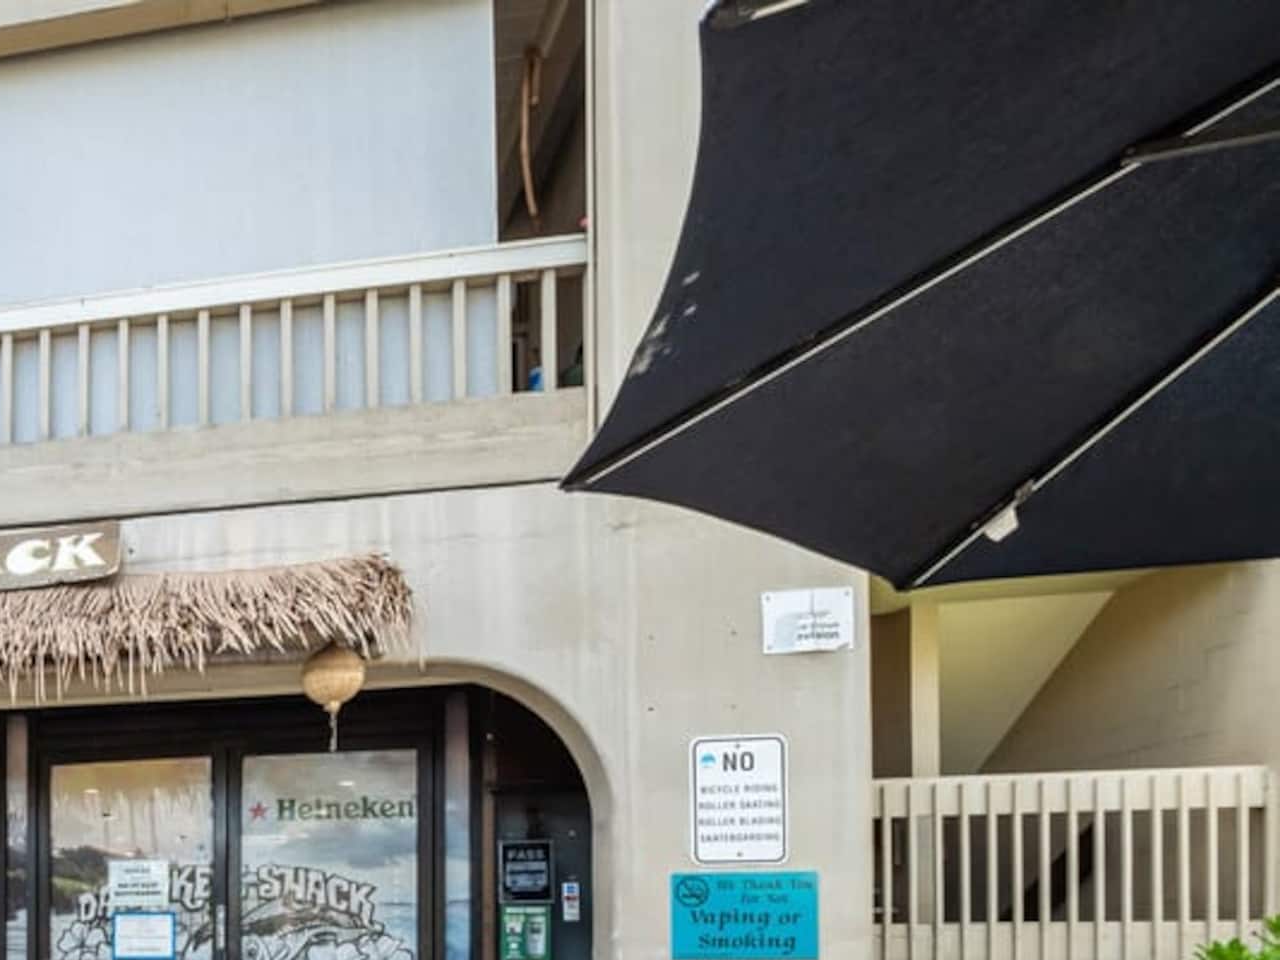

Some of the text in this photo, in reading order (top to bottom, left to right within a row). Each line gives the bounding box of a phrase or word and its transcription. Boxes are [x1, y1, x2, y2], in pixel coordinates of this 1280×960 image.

[723, 751, 755, 772] NO
[276, 796, 415, 821] Heineken
[256, 864, 380, 927] SHACK
[690, 908, 802, 931] Vaping or
[698, 933, 796, 955] Smoking
